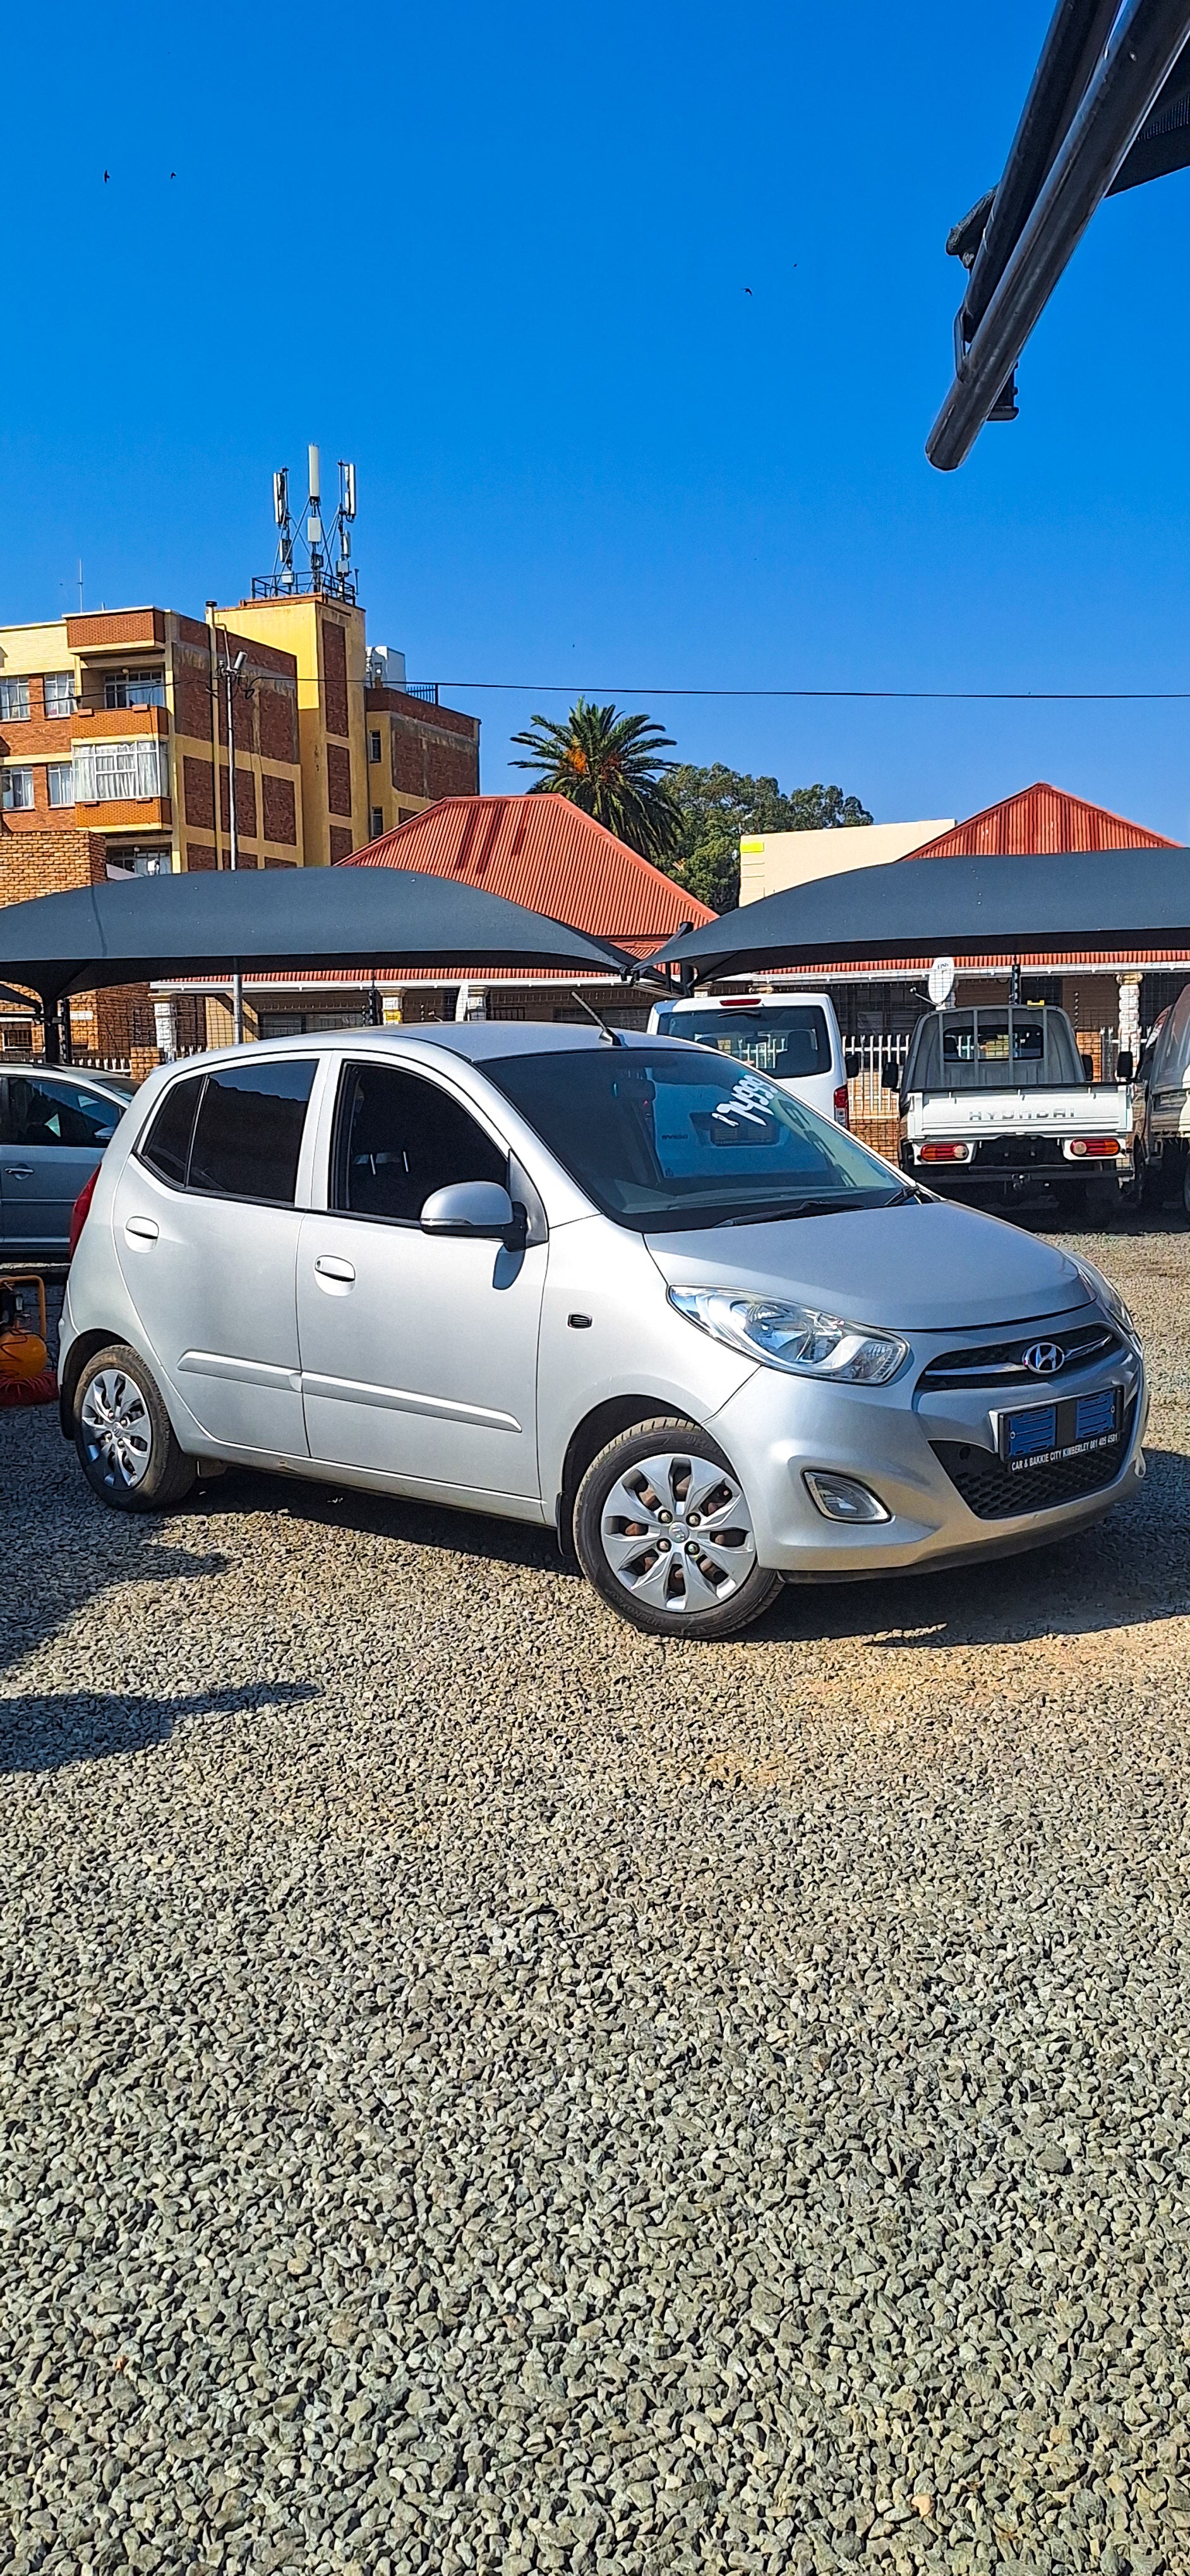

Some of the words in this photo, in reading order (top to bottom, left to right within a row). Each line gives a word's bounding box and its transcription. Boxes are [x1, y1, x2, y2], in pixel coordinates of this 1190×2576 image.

[969, 1108, 1075, 1121] HYUNDAI
[1012, 1460, 1023, 1471] CAR
[1030, 1453, 1050, 1467] BAKKIE
[1050, 1449, 1062, 1461] CITY
